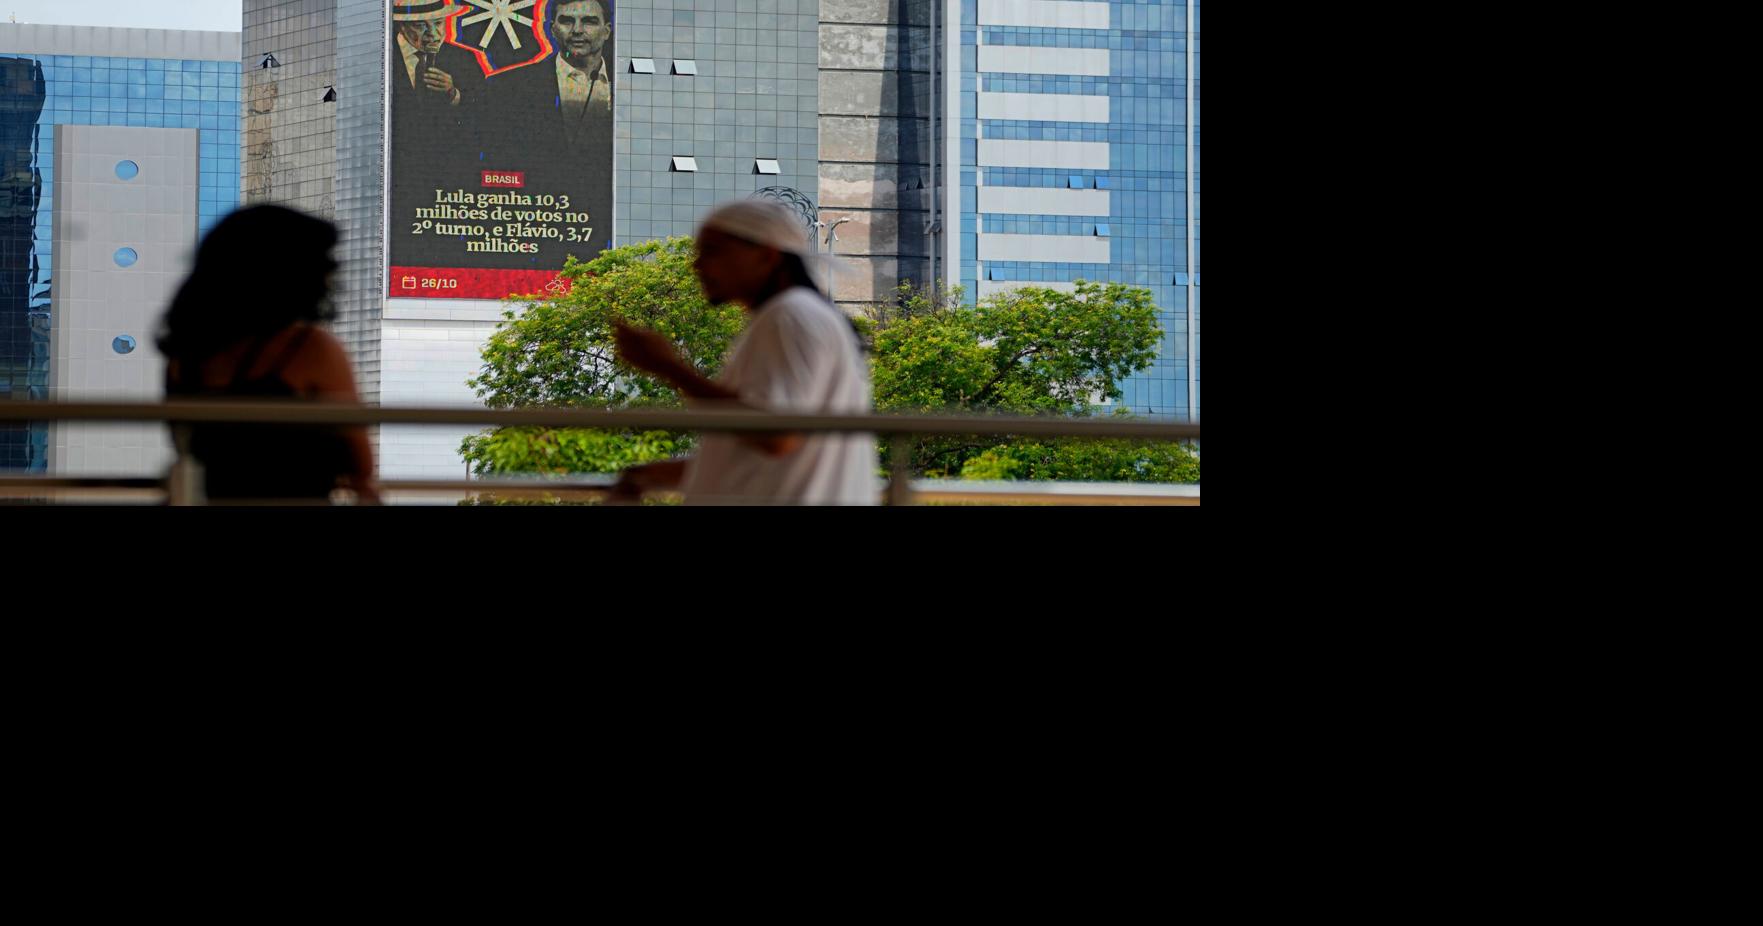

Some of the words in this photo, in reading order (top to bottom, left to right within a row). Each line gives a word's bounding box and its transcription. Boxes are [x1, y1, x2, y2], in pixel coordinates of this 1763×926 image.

[485, 175, 520, 184] BRASIL
[436, 189, 474, 204] Lula
[478, 191, 531, 207] ganha
[536, 195, 569, 210] 10,3
[416, 205, 488, 220] milhões
[491, 208, 511, 221] de
[516, 210, 562, 222] votos
[566, 212, 588, 222] no
[435, 224, 489, 238] turno,
[493, 227, 502, 236] e
[506, 223, 563, 241] Flávio,
[567, 228, 592, 242] 3,7
[467, 238, 538, 253] milhões
[422, 279, 456, 288] 26/10
